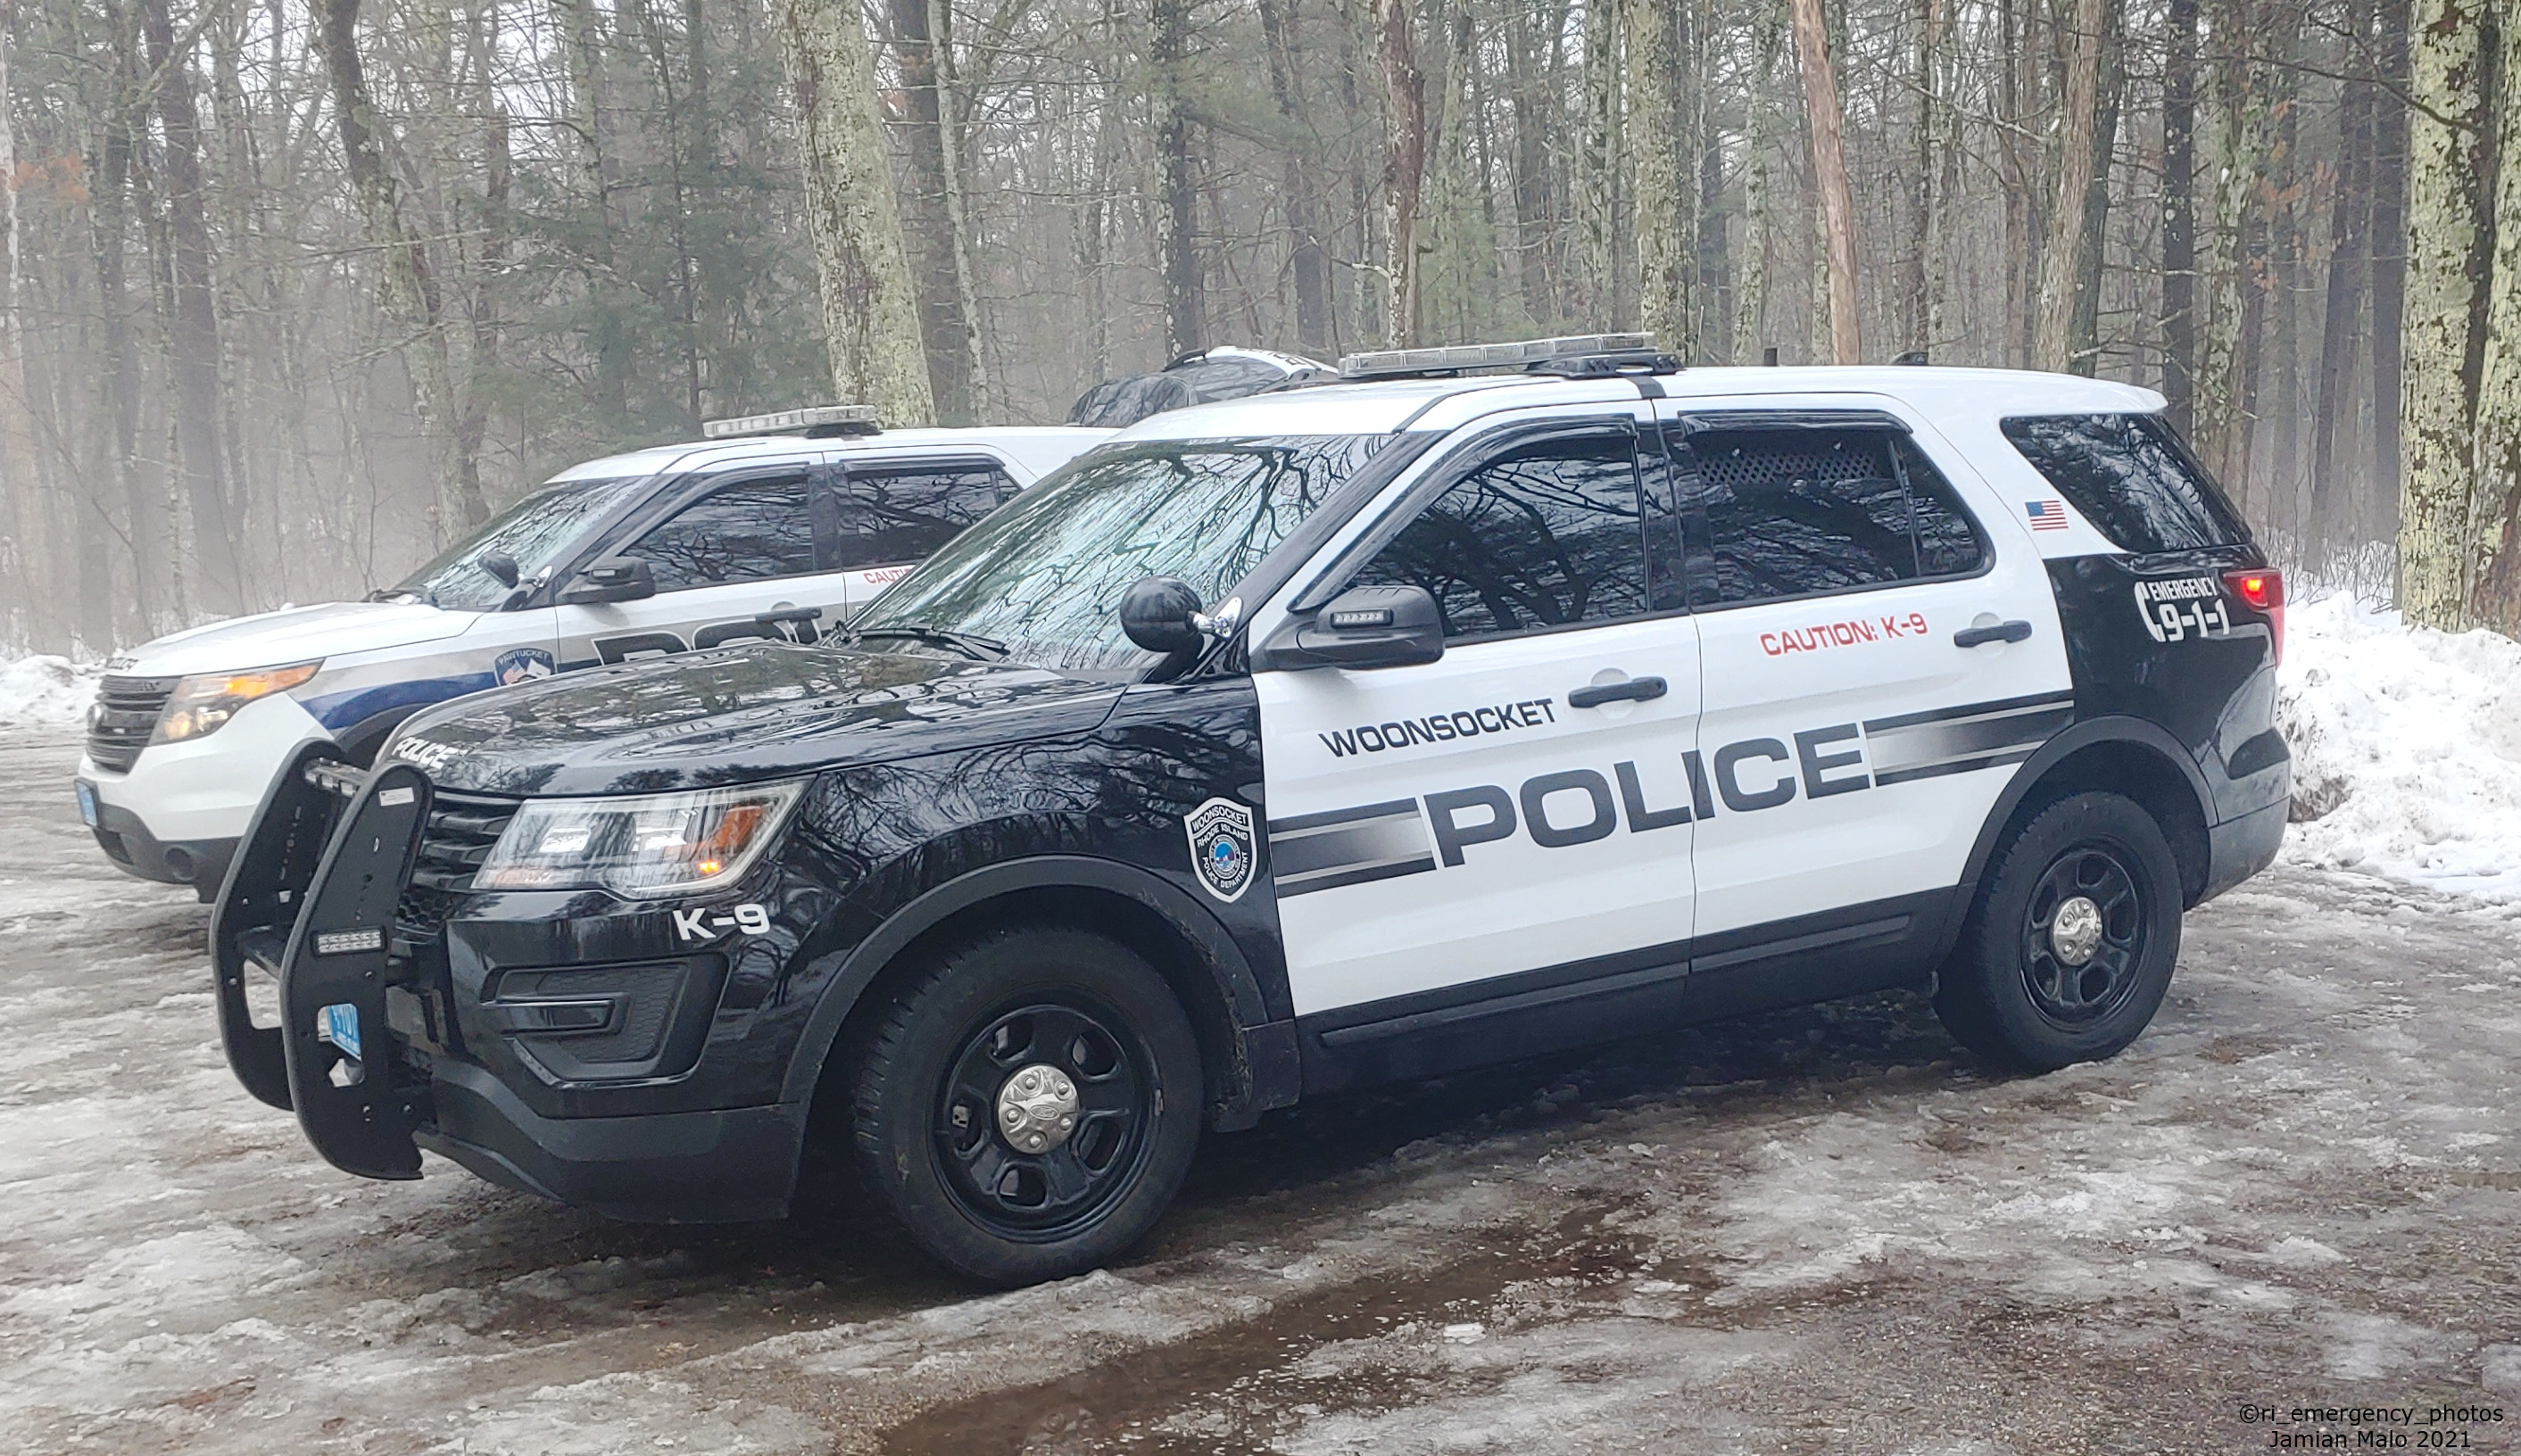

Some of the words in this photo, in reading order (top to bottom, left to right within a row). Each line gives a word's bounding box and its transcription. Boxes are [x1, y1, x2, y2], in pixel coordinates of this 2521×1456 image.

[863, 568, 910, 584] CAUTI
[2147, 576, 2218, 601] EMERGENCY
[1760, 619, 1879, 656] CAUTION:
[1880, 613, 1928, 639] K-9
[2159, 599, 2230, 641] 9-1-1
[497, 649, 550, 666] PAWTUCKET
[1318, 698, 1555, 757] WOONSOCKET
[391, 737, 460, 770] POLICE
[1423, 723, 1870, 868] POLICE
[1191, 806, 1247, 831] WOONSOCKET
[1197, 823, 1220, 848] RHODE
[1220, 823, 1248, 841] ISLAND
[1202, 856, 1218, 885] POLICE
[1220, 851, 1249, 889] DEPARTMENT
[672, 903, 770, 941] K-9
